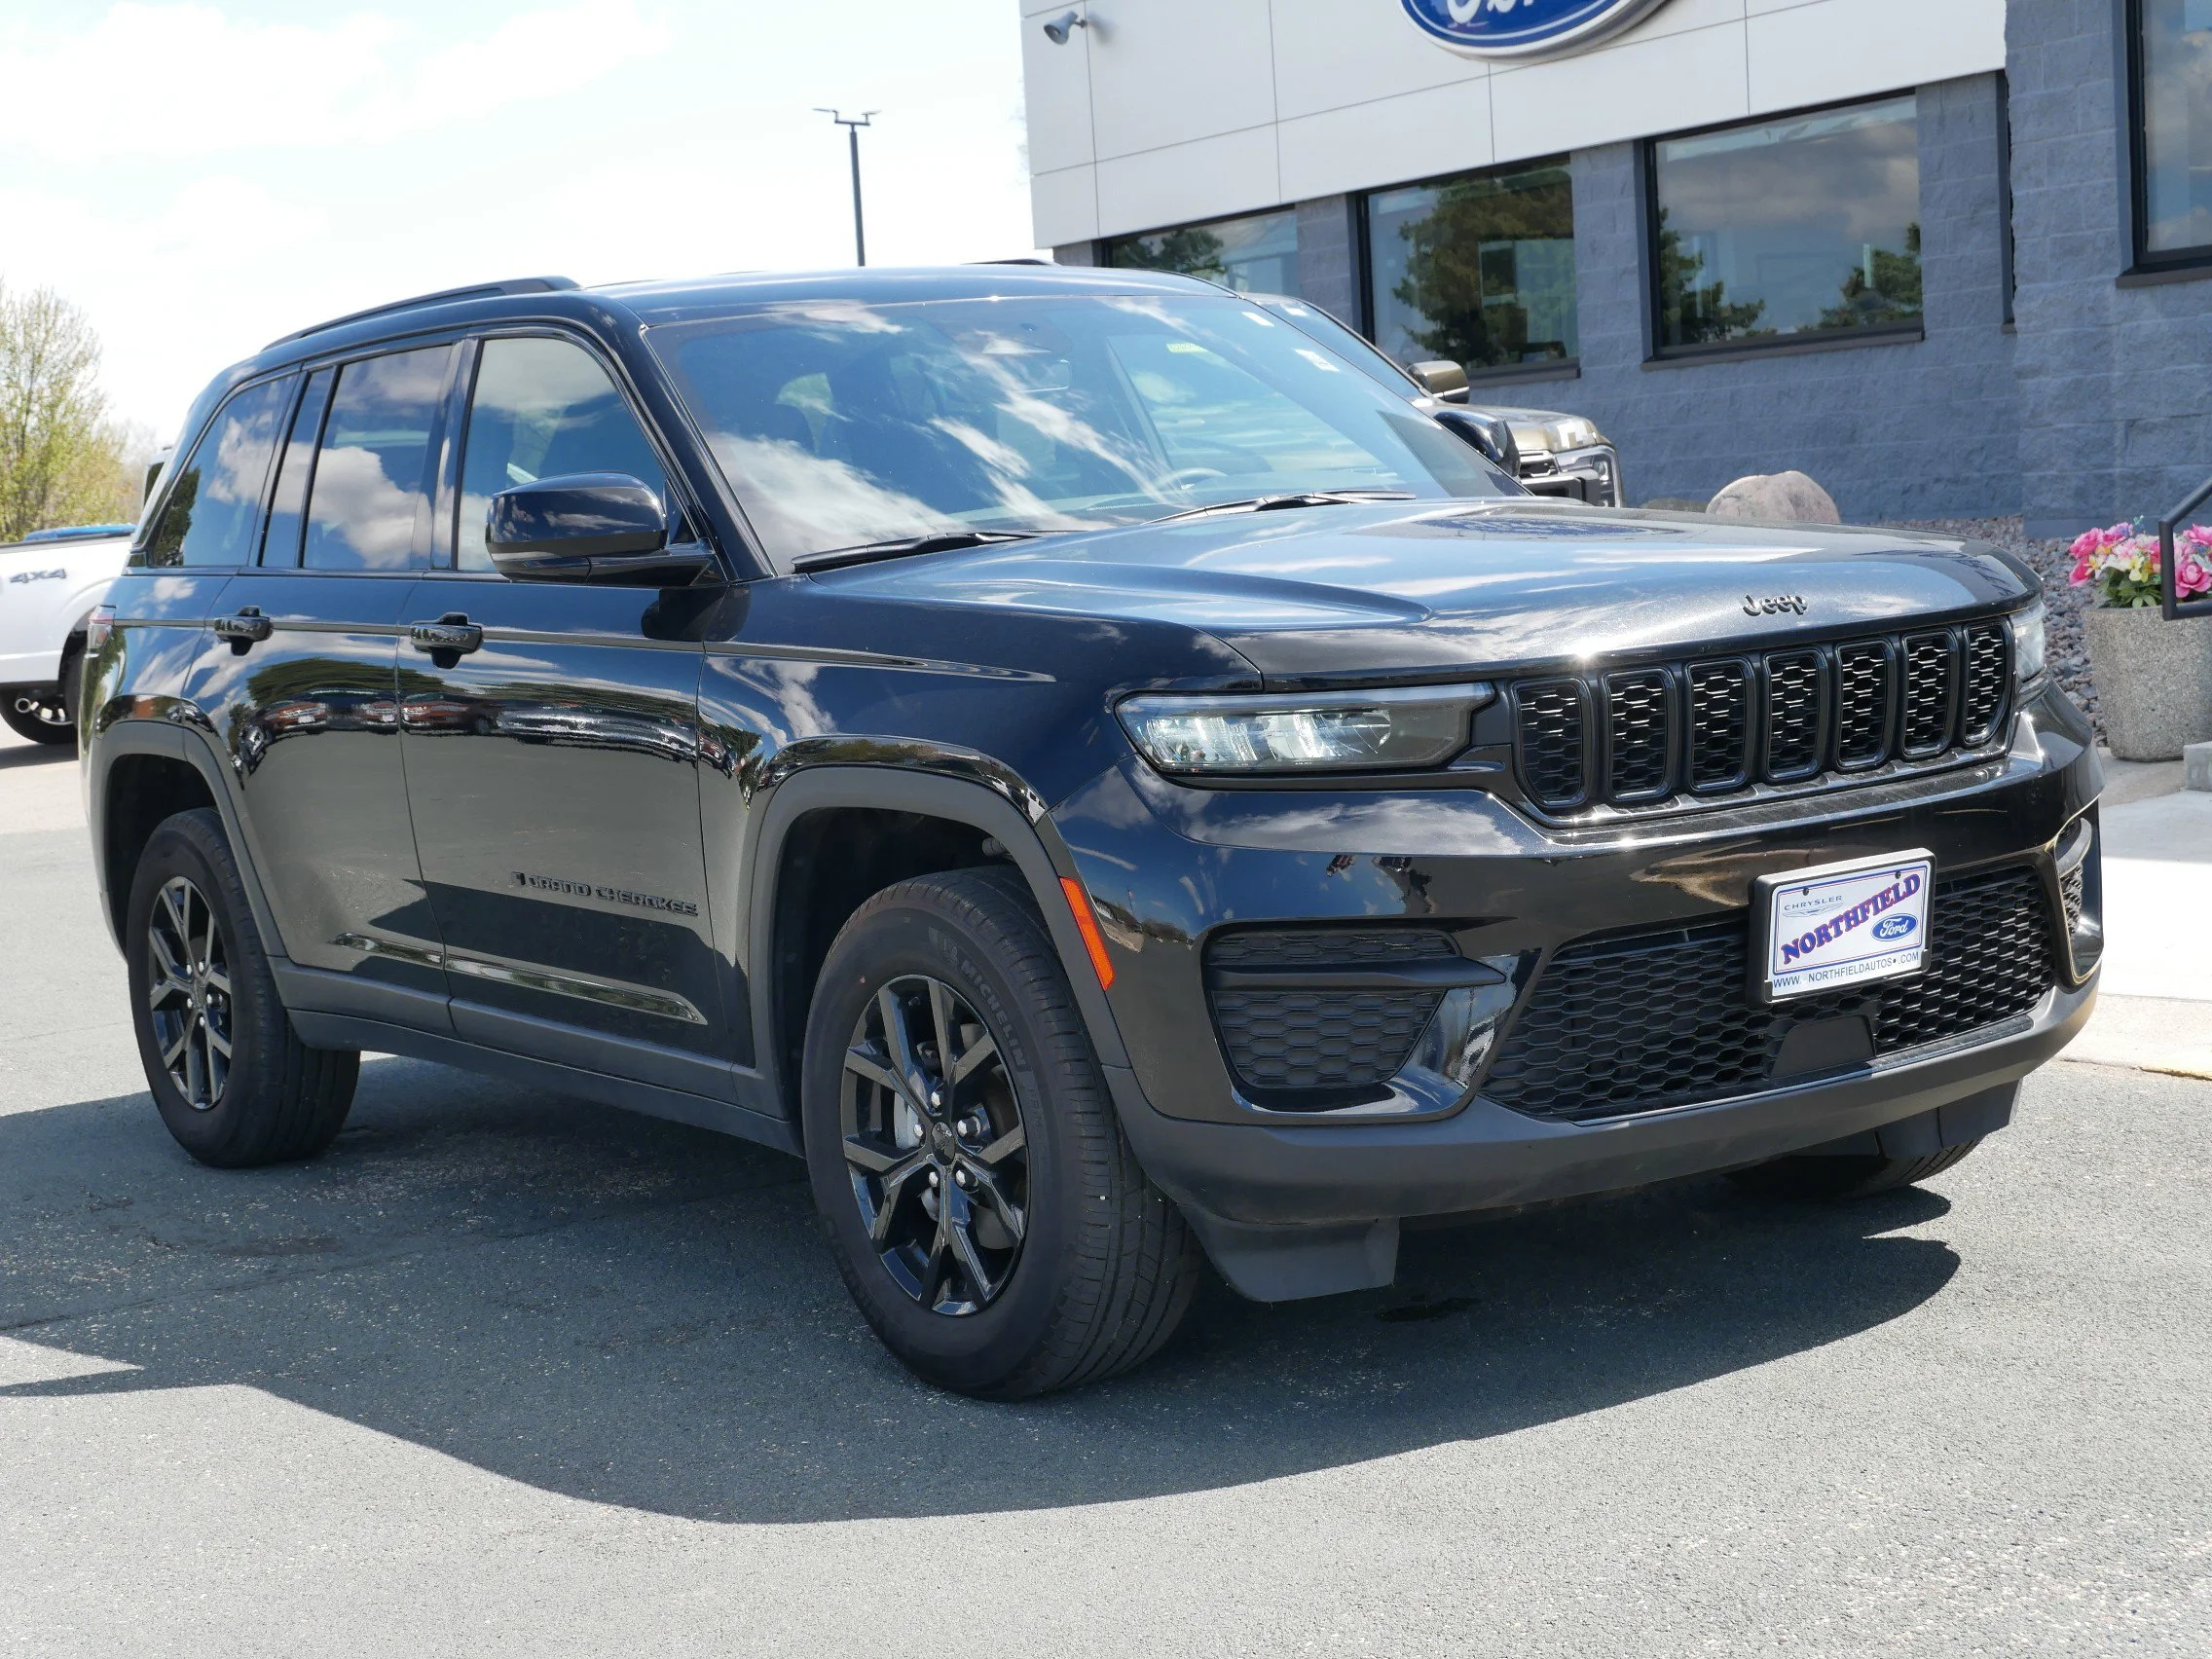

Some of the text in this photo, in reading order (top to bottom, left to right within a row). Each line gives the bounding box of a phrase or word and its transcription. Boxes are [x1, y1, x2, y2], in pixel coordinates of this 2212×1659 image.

[1742, 593, 1808, 617] Jeep
[595, 887, 698, 916] CHEROKEE
[1784, 895, 1842, 910] CHRYSLER
[1781, 873, 1921, 965] NORTHFIELD
[1880, 918, 1909, 937] Ford
[960, 959, 1026, 1067] MICHELIN
